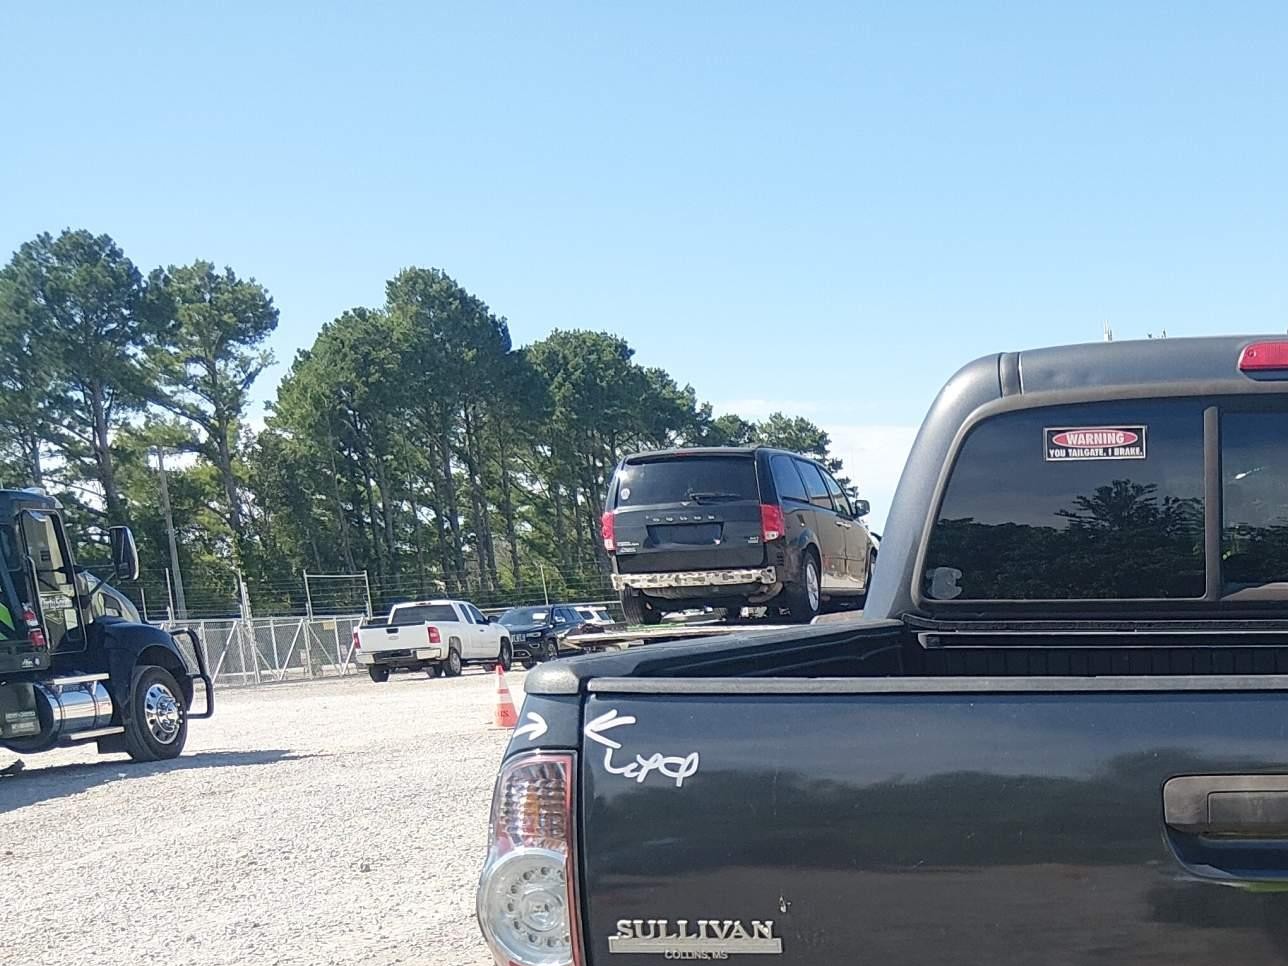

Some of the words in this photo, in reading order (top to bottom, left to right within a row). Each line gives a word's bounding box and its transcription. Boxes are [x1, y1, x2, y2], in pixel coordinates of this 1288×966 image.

[1066, 432, 1124, 445] WARNING
[1049, 448, 1066, 457] YOU
[616, 919, 774, 940] SULLIVAN
[664, 950, 711, 960] COLLINS,
[714, 950, 728, 960] MS
